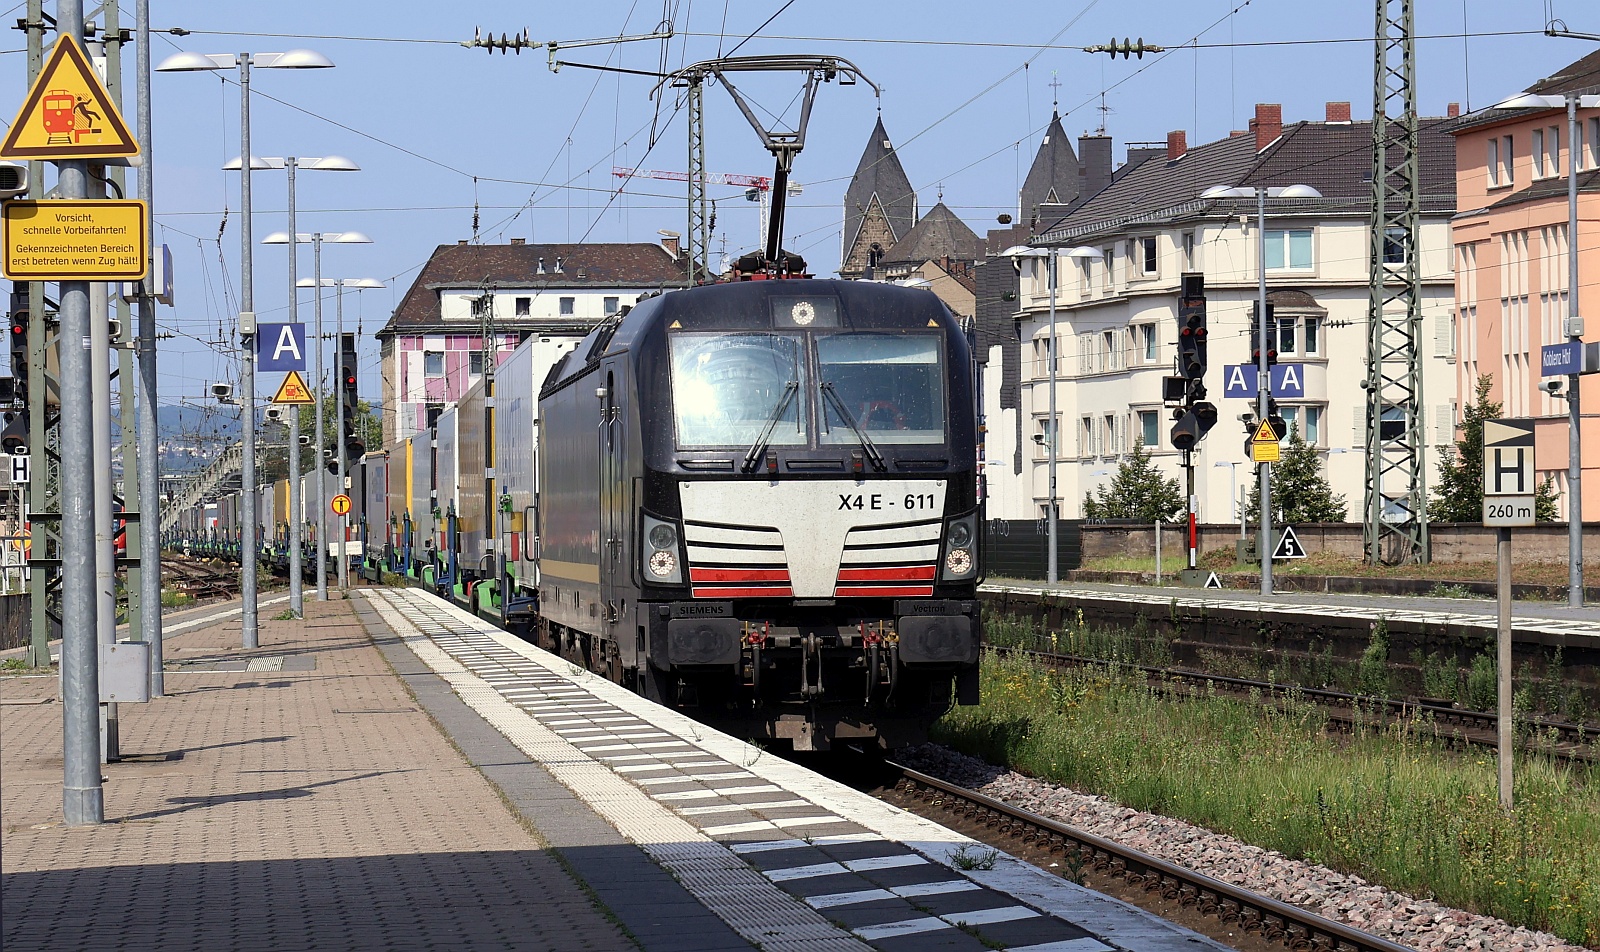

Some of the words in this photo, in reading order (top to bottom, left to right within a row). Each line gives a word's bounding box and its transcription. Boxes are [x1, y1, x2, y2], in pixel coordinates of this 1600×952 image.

[55, 213, 95, 223] Vorsicht,
[23, 225, 61, 235] schnelle
[63, 225, 127, 235] Vorbeifahrten!
[16, 244, 98, 253] Gekennzeichneten
[100, 244, 134, 253] Bereich
[12, 257, 30, 265] erst
[32, 257, 69, 265] betreten
[98, 256, 115, 267] Zug
[118, 256, 138, 265] hält!
[272, 325, 302, 360] A
[1542, 350, 1561, 367] Koblenz
[1562, 348, 1571, 365] Hbf
[1227, 366, 1248, 391] A
[1280, 365, 1301, 390] A
[12, 457, 27, 480] H
[1494, 448, 1524, 492] H
[904, 494, 934, 510] 611
[1488, 505, 1513, 518] 260
[1518, 507, 1531, 518] m
[1285, 538, 1294, 556] 5
[680, 606, 724, 615] SIEMENS
[913, 604, 946, 613] Vectron
